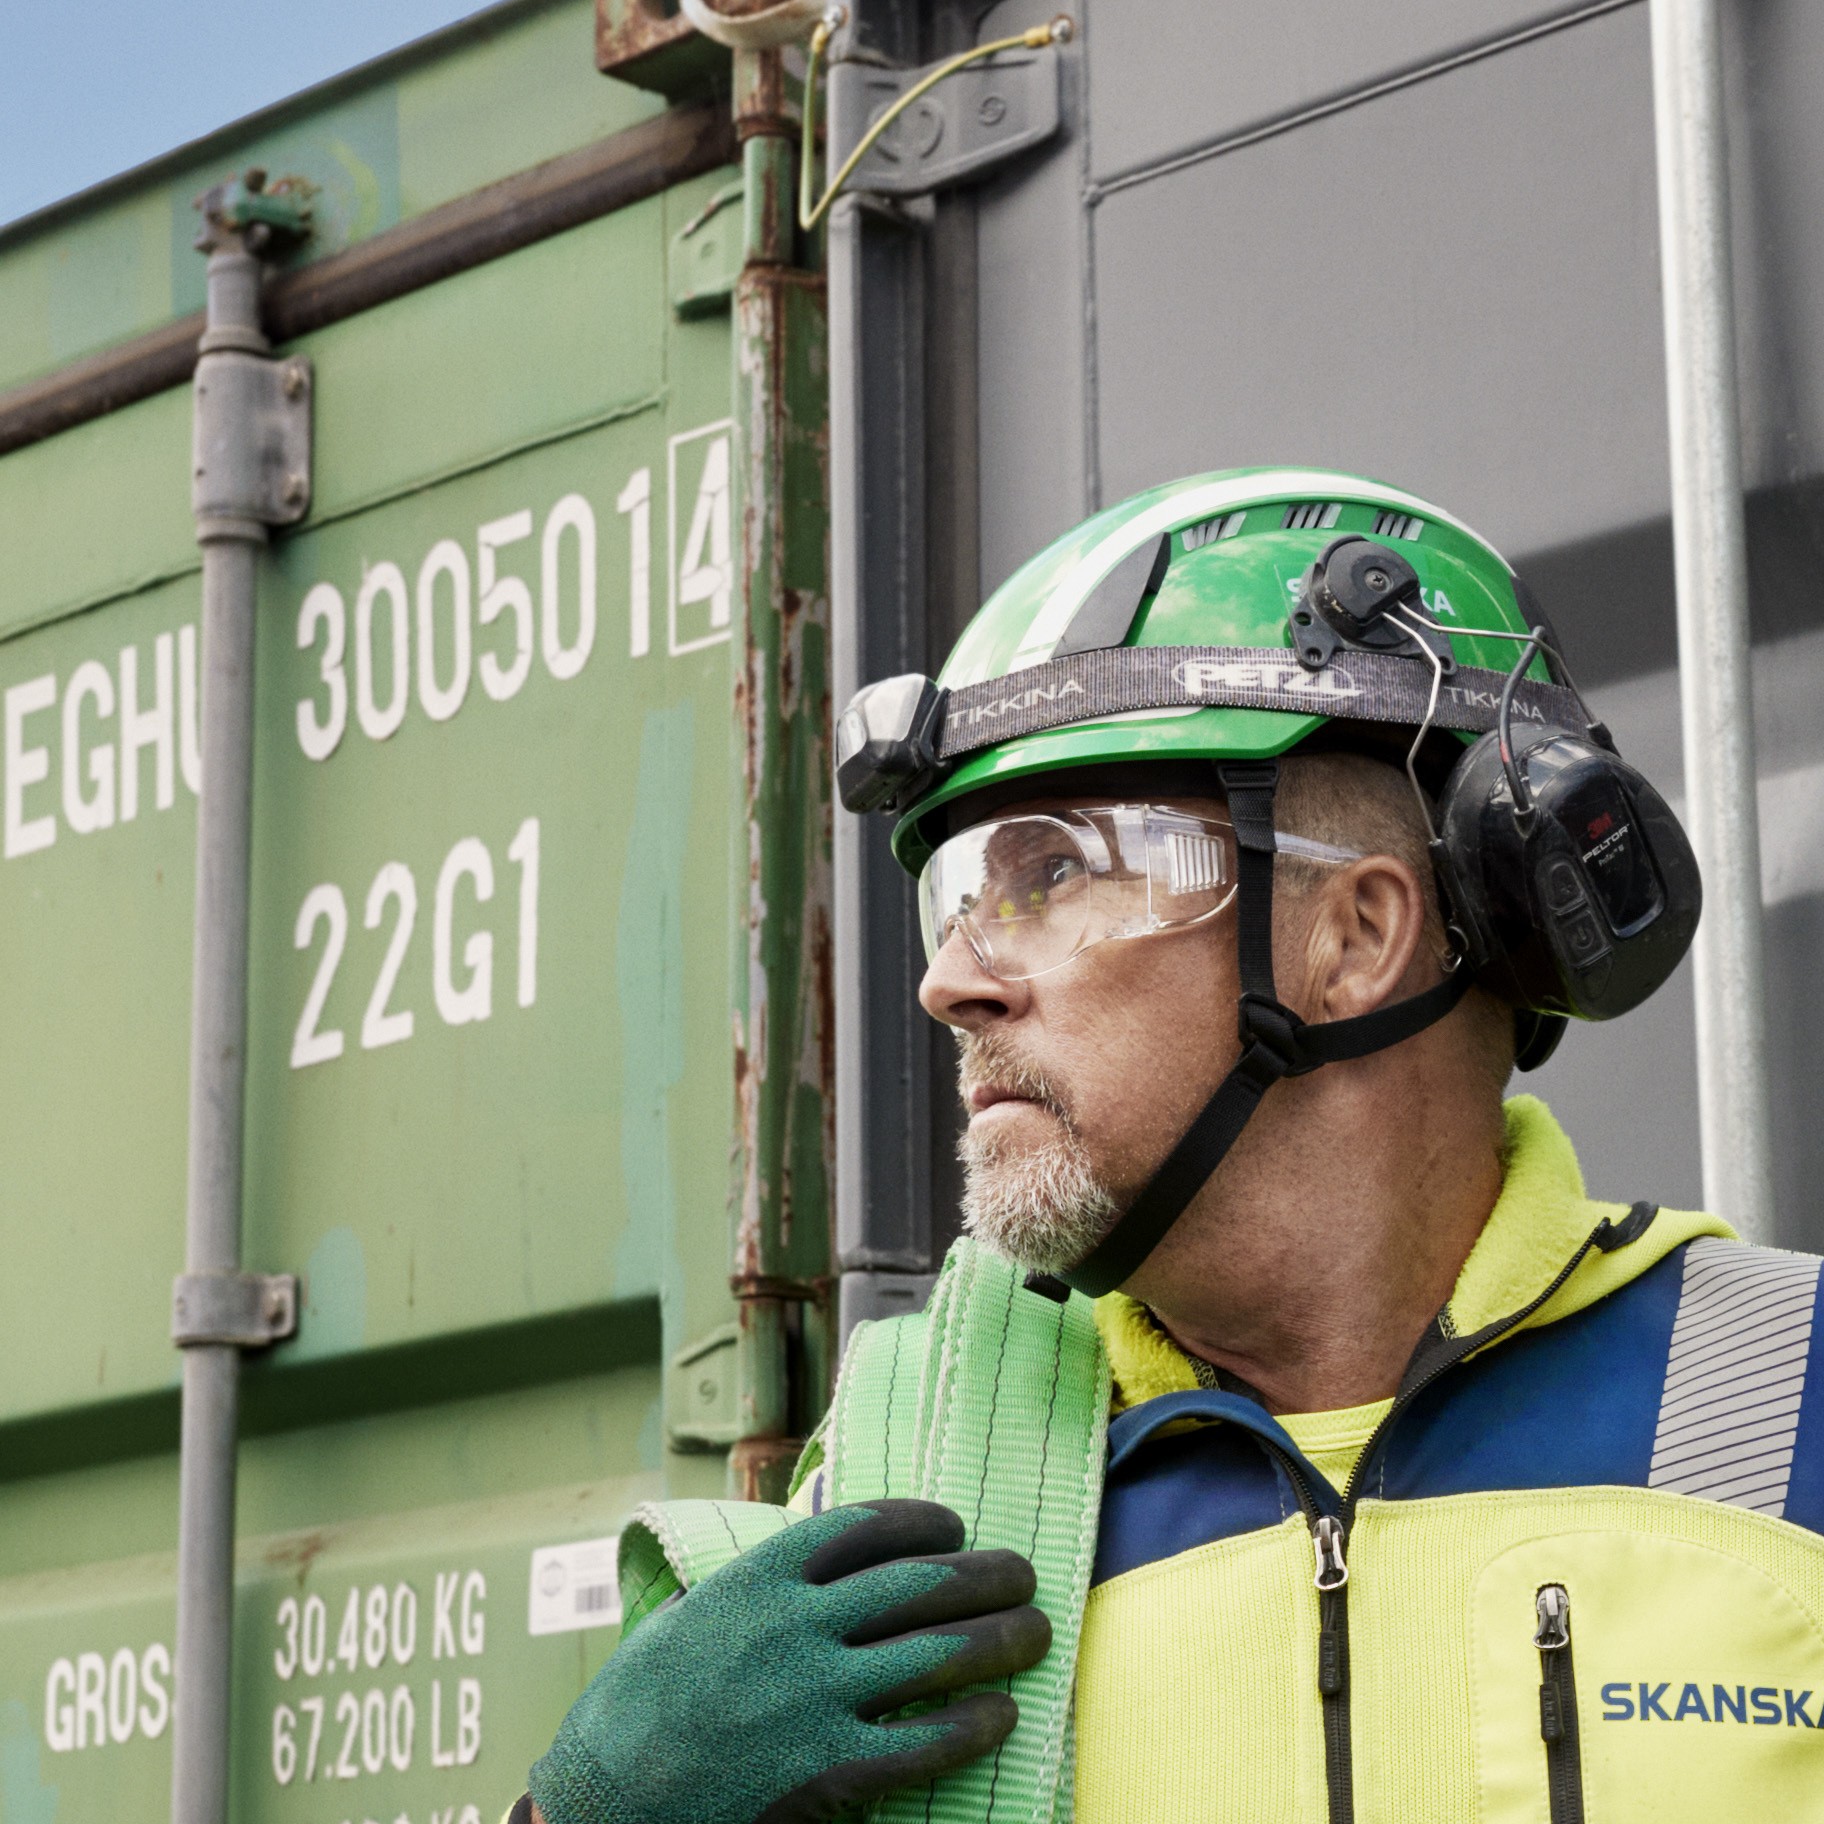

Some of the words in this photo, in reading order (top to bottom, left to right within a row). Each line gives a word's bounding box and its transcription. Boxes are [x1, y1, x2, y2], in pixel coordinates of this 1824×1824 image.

[946, 679, 1086, 729] TIKKINA
[1184, 663, 1364, 695] PETZL
[1443, 686, 1546, 724] TIKKNA
[1587, 811, 1614, 840] 3M
[291, 818, 540, 1068] 22G1
[275, 1584, 416, 1679] 30.480
[432, 1571, 486, 1659] KG
[46, 1644, 177, 1751] GROS
[272, 1686, 415, 1785] 67.200
[431, 1678, 482, 1768] LB
